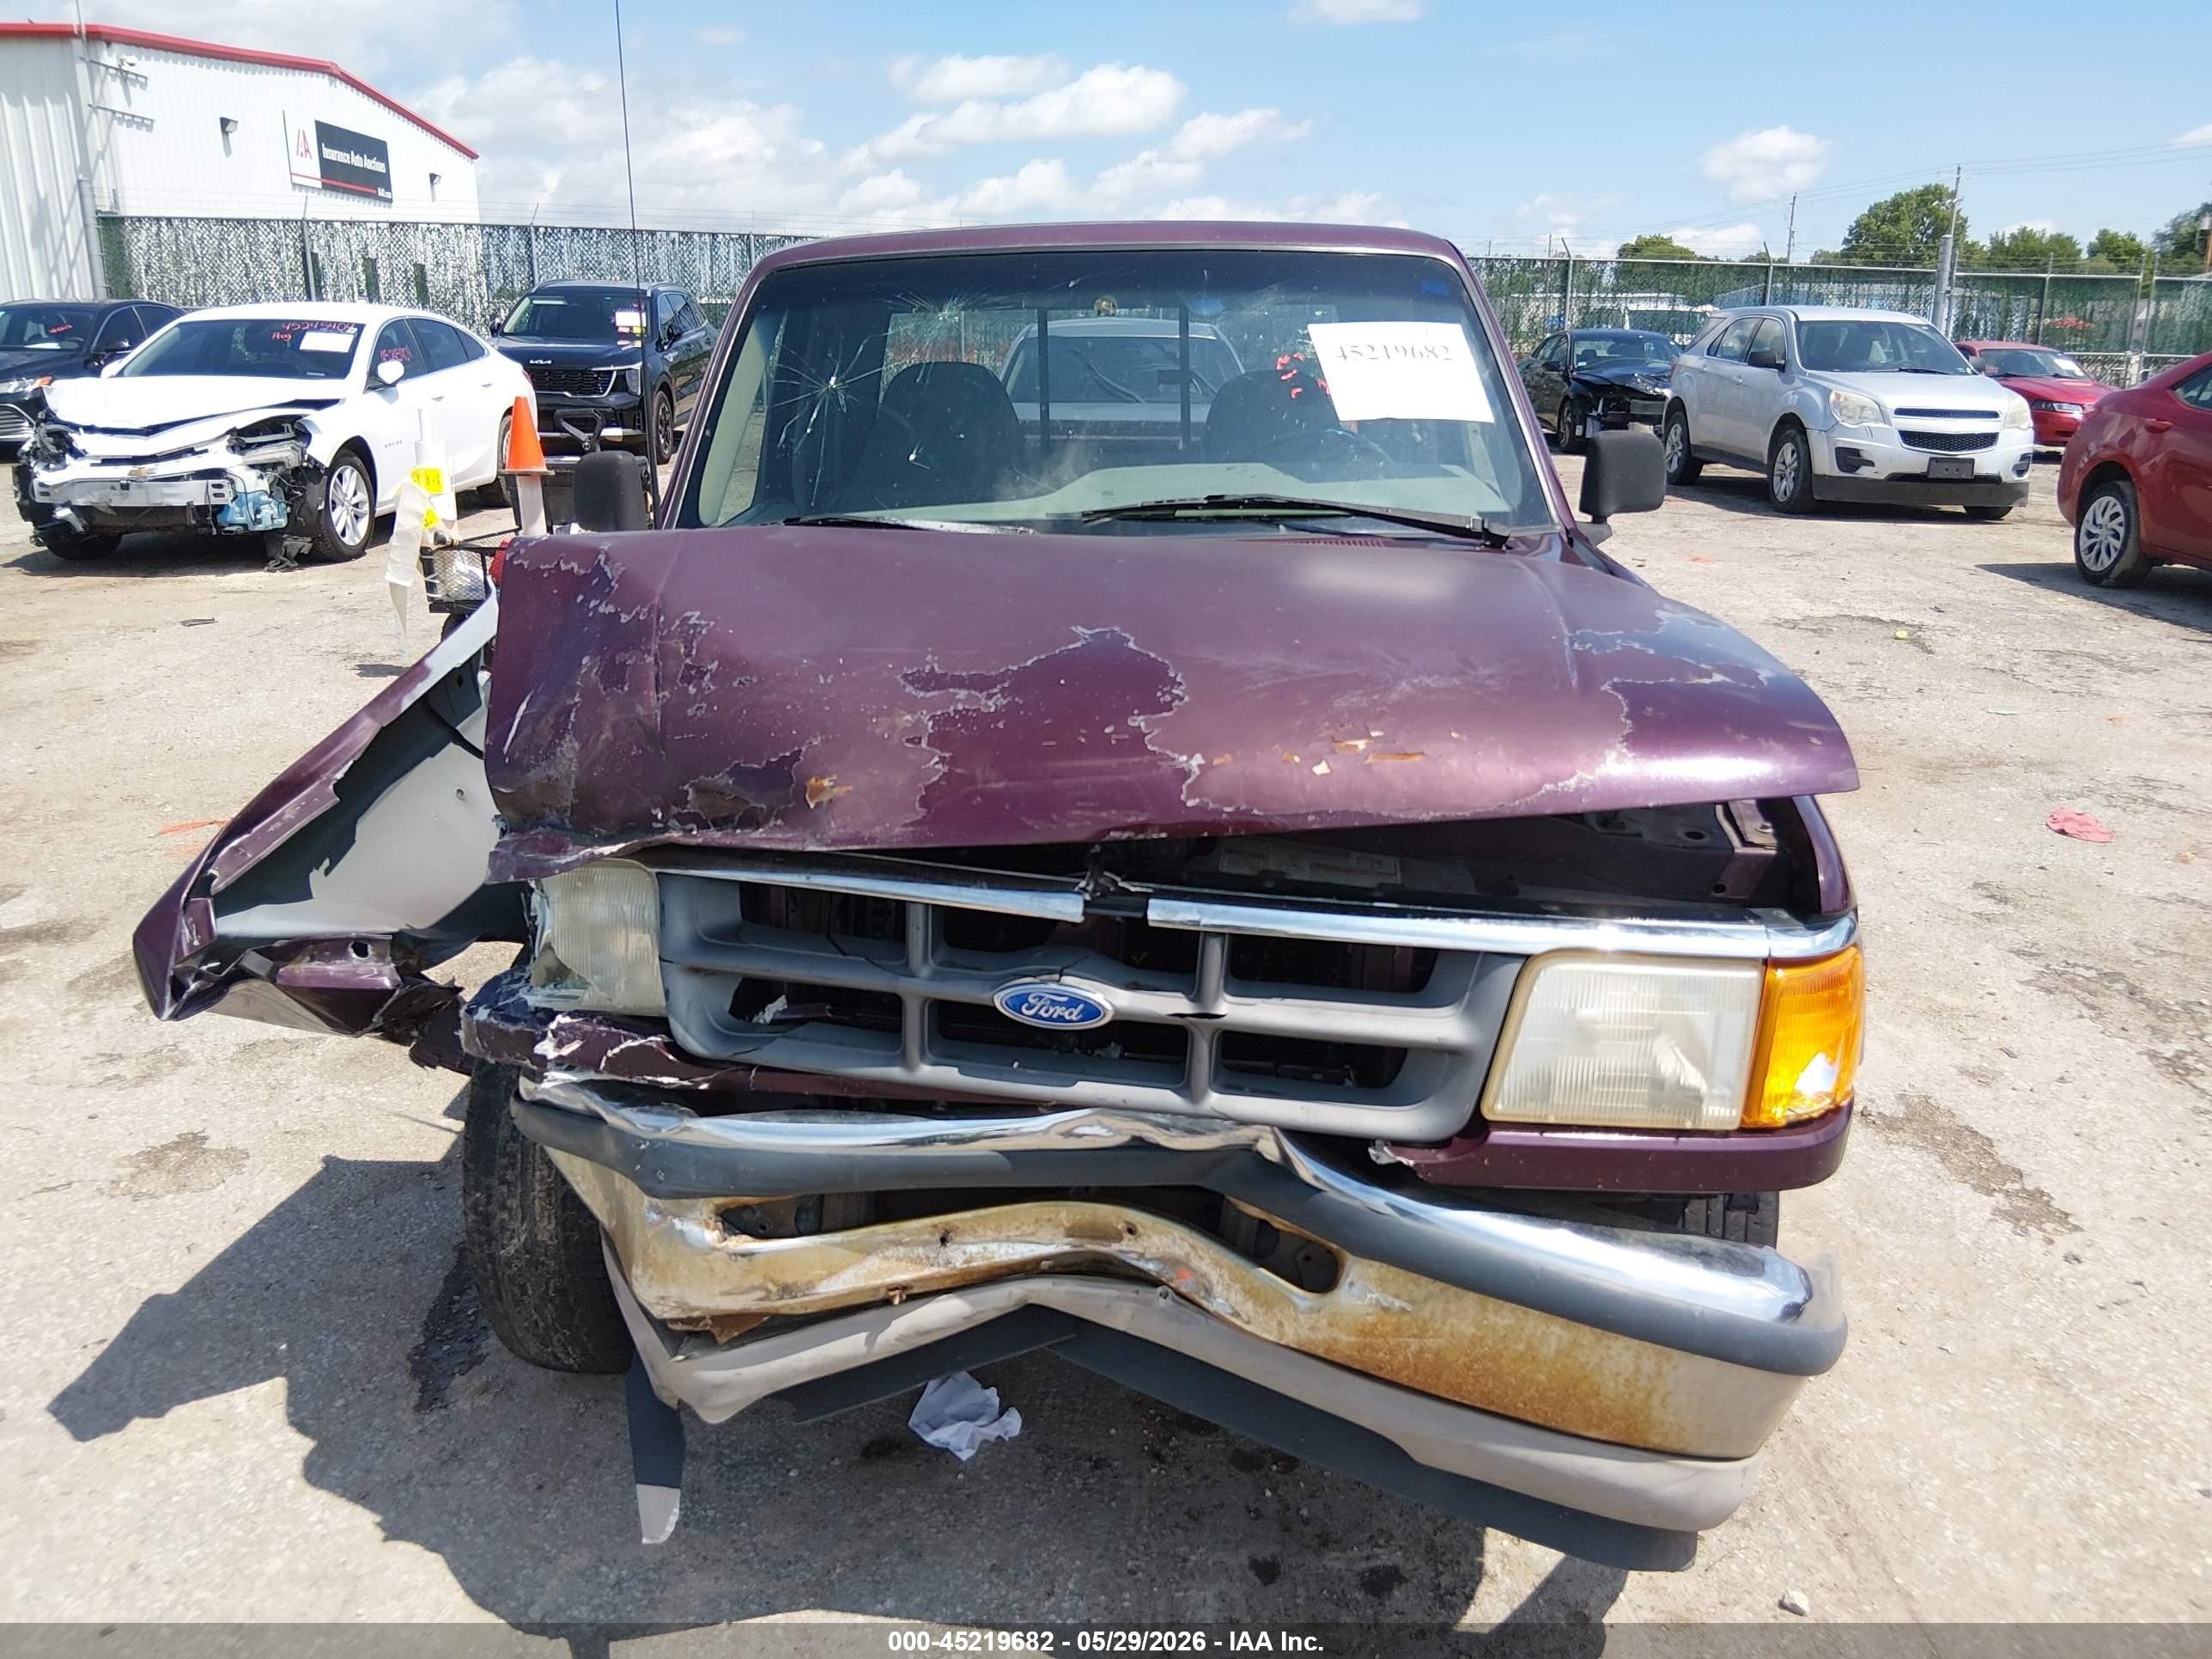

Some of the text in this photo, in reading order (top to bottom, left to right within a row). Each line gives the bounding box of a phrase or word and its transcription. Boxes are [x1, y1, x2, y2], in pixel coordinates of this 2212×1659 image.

[321, 142, 386, 173] Insurance Auto Auctions
[1021, 992, 1085, 1021] Ford
